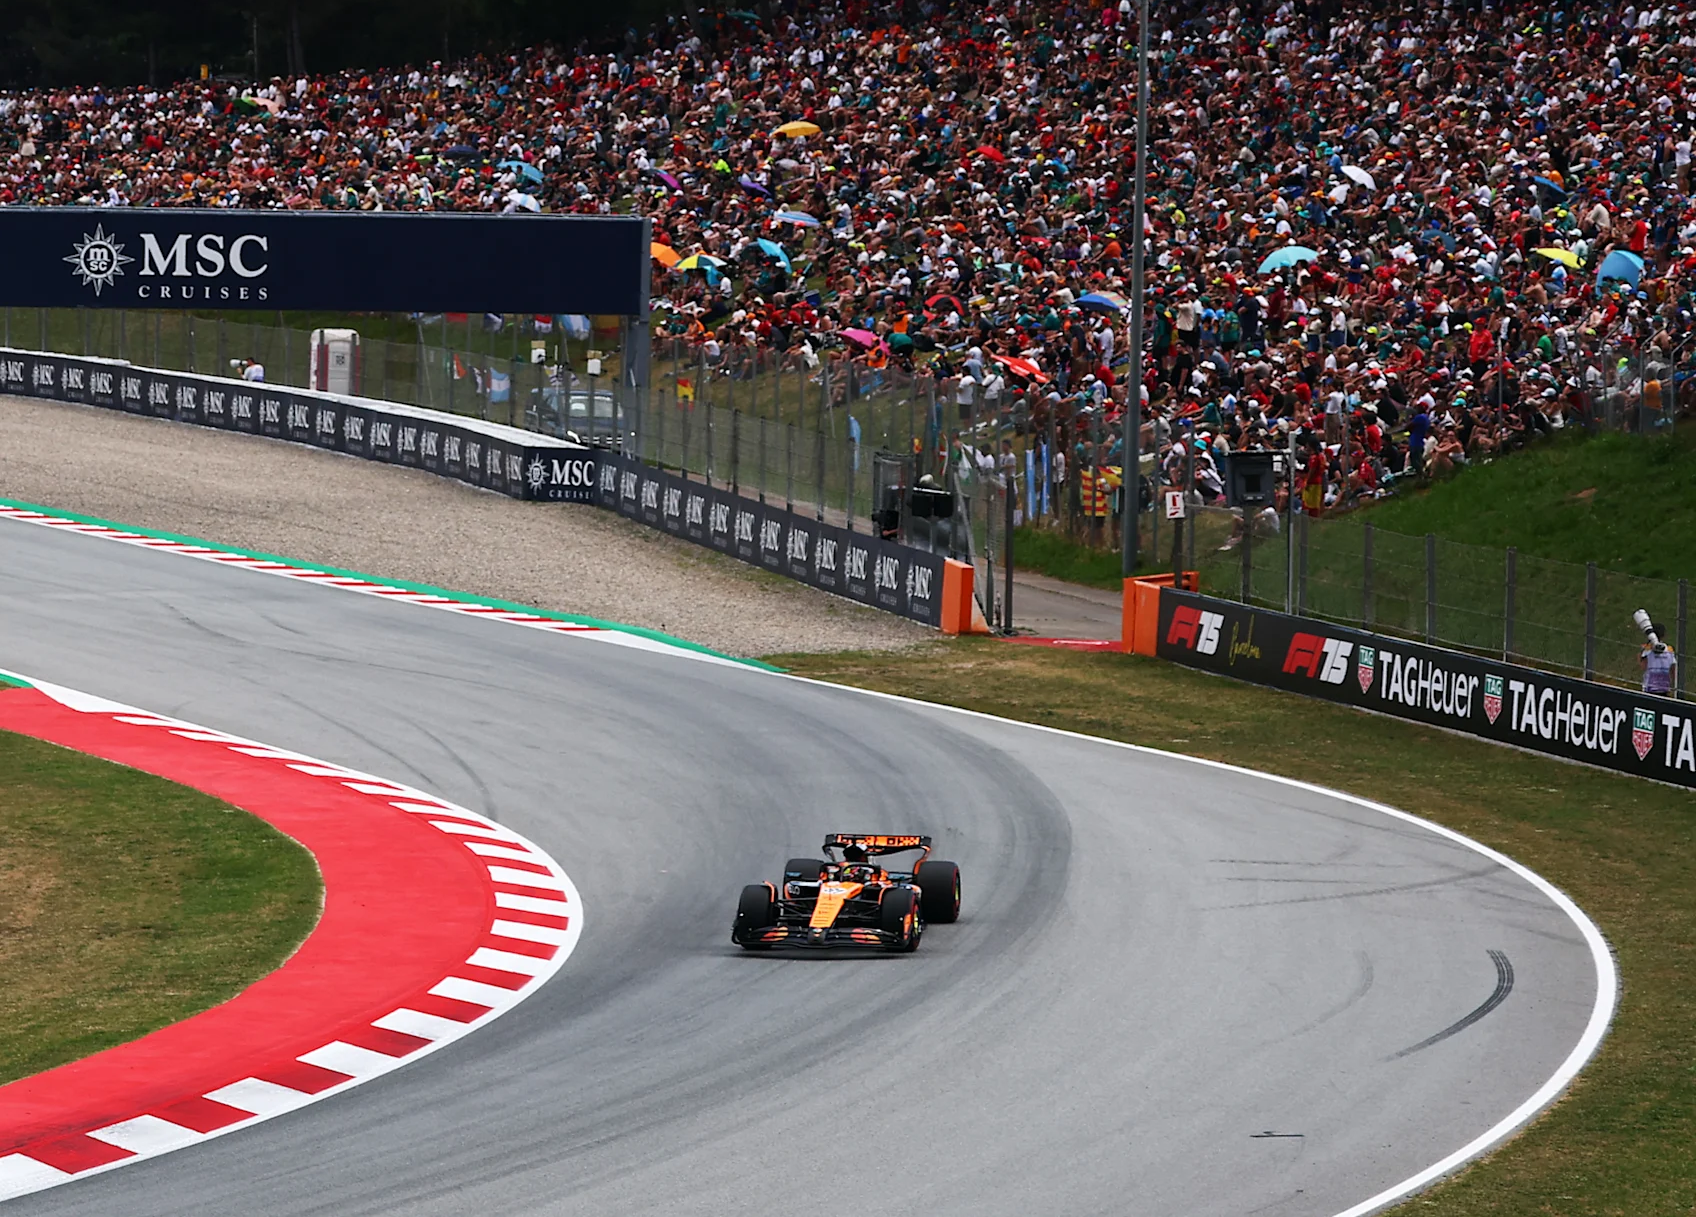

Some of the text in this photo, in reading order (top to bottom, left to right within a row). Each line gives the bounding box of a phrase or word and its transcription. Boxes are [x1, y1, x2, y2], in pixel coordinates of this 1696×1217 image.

[139, 233, 269, 278] MSC
[139, 285, 269, 300] CRUISES
[7, 361, 24, 382] MSC
[39, 364, 54, 385] MSC
[68, 368, 84, 389] MSC
[96, 372, 113, 394] MSC
[126, 377, 141, 399] MSC
[155, 382, 169, 404] MSC
[182, 386, 197, 409] MSC
[210, 391, 225, 414] MSC
[238, 395, 252, 418] MSC
[265, 399, 280, 422] MSC
[294, 404, 309, 428] MSC
[322, 410, 335, 434] MSC
[350, 416, 364, 441] MSC
[375, 422, 392, 447] MSC
[404, 427, 417, 451] MSC
[550, 459, 595, 487] MSC
[668, 488, 682, 517] MSC
[691, 495, 704, 524] MSC
[715, 503, 729, 533] MSC
[740, 511, 754, 541] MSC
[766, 520, 780, 551] MSC
[793, 529, 808, 561] MSC
[821, 538, 838, 571] MSC
[851, 547, 868, 580] MSC
[881, 556, 899, 590] MSC
[914, 565, 932, 600] MSC
[1359, 648, 1374, 666] TAG
[1379, 650, 1479, 719] TAGHeuer
[1486, 676, 1503, 695] TAG
[1509, 680, 1627, 754] TAGHeuer
[1635, 710, 1655, 730] TAG
